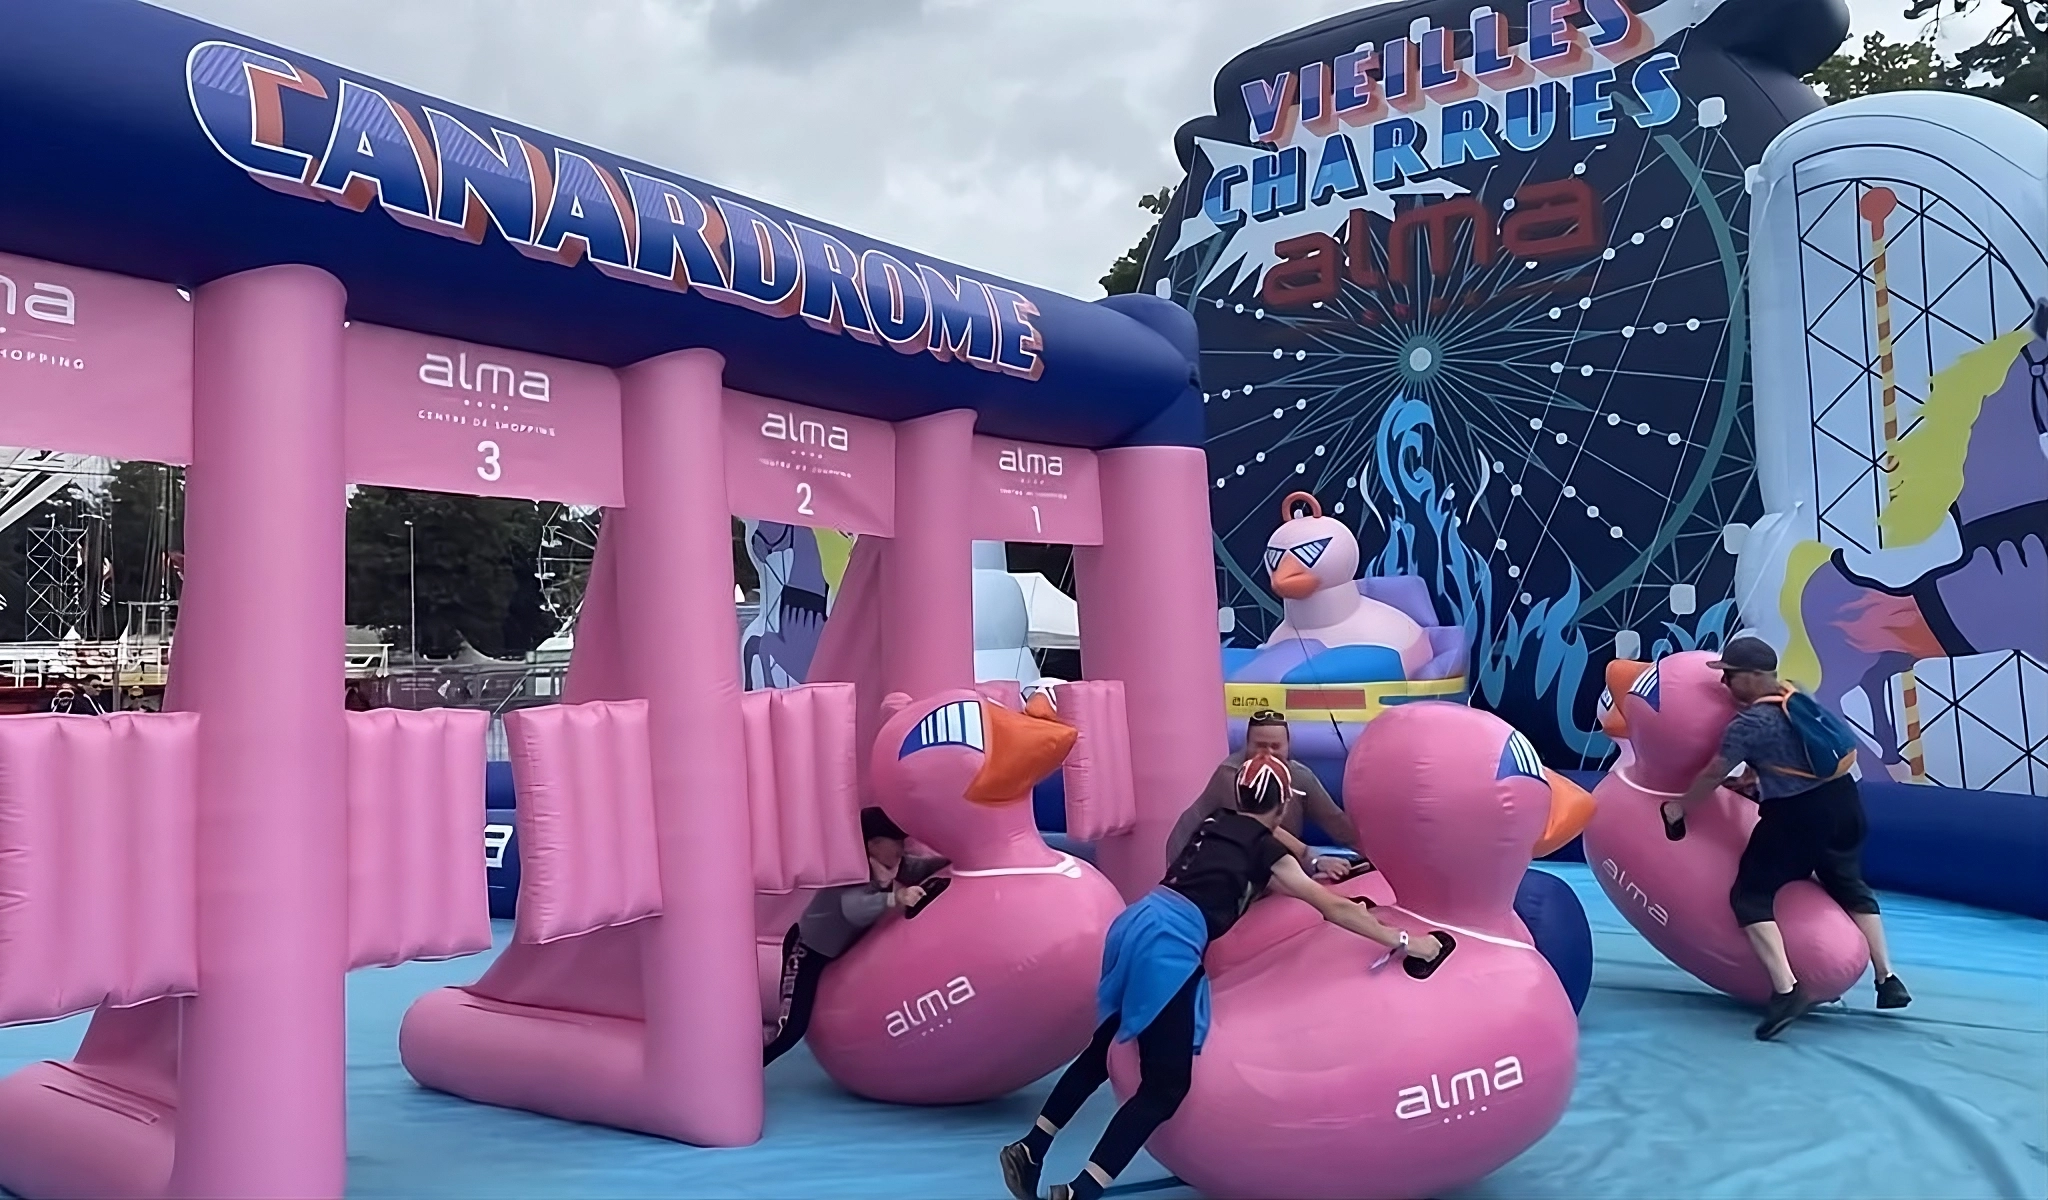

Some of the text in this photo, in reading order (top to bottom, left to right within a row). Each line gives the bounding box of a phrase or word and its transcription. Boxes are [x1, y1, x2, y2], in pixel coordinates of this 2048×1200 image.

[1240, 0, 1652, 144] VIEILLES
[1204, 52, 1681, 228] CHARRUES
[186, 40, 1044, 380] CANARDROME
[1262, 178, 1604, 304] alma
[419, 352, 550, 403] alma
[477, 440, 501, 481] 3
[761, 412, 848, 452] alma
[999, 447, 1063, 476] alma
[796, 482, 815, 516] 2
[1031, 505, 1042, 534] 1
[1601, 858, 1669, 926] alma
[885, 975, 976, 1038] alma
[1395, 1055, 1524, 1120] alma
